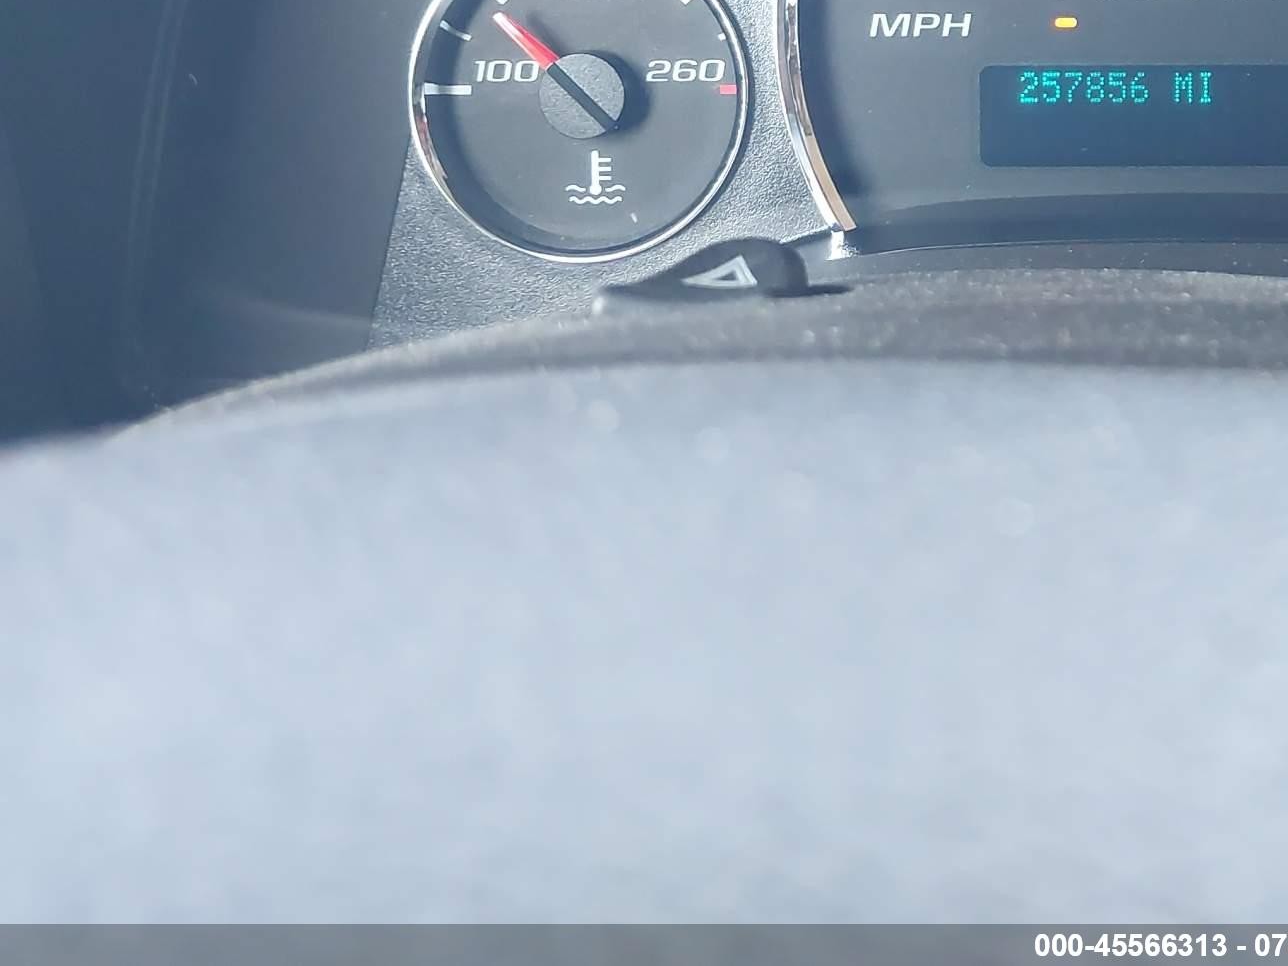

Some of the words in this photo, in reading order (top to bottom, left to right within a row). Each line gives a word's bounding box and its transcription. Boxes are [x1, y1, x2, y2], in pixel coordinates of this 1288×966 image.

[869, 12, 972, 38] MPH
[475, 60, 539, 83] 100
[646, 59, 726, 82] 260
[1018, 72, 1149, 103] 257856
[1173, 72, 1212, 103] MI
